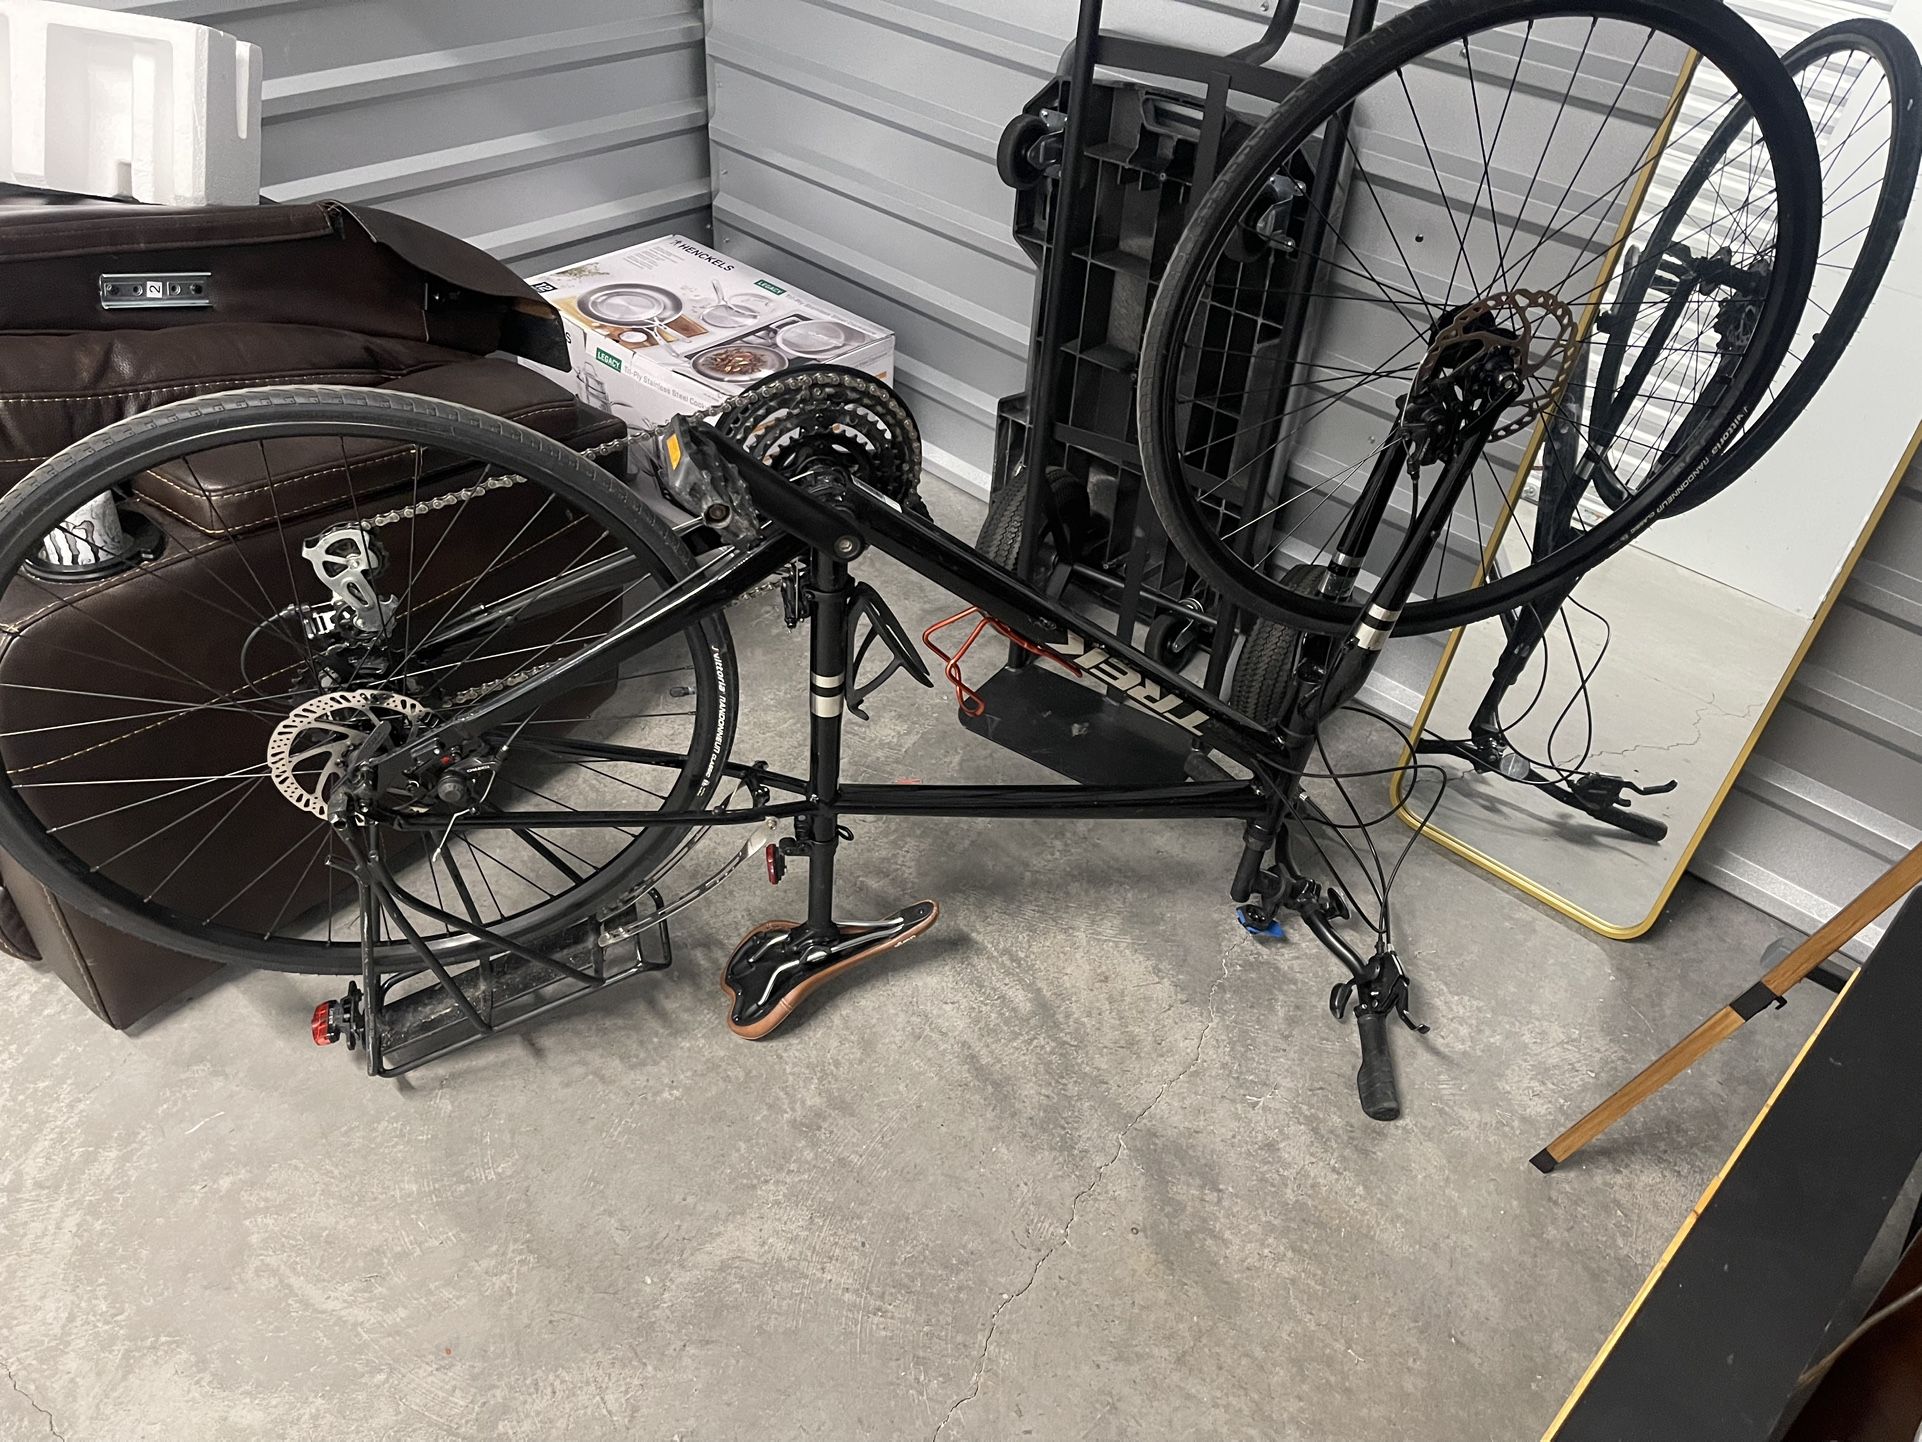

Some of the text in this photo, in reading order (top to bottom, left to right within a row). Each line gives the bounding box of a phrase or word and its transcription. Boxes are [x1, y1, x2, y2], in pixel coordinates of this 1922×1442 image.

[678, 243, 735, 272] HENCKELS
[149, 285, 160, 294] 2
[758, 281, 783, 296] LEGACY
[597, 351, 622, 370] LEGACY
[624, 366, 643, 382] Tri-Ply
[643, 376, 671, 395] Stainless
[690, 397, 706, 409] Cook
[1711, 413, 1745, 455] vittoria
[1656, 458, 1710, 514] RANDONNEUR
[713, 652, 726, 693] vittoria
[1045, 629, 1210, 736] TREK
[713, 695, 727, 754] RANDONNEUR
